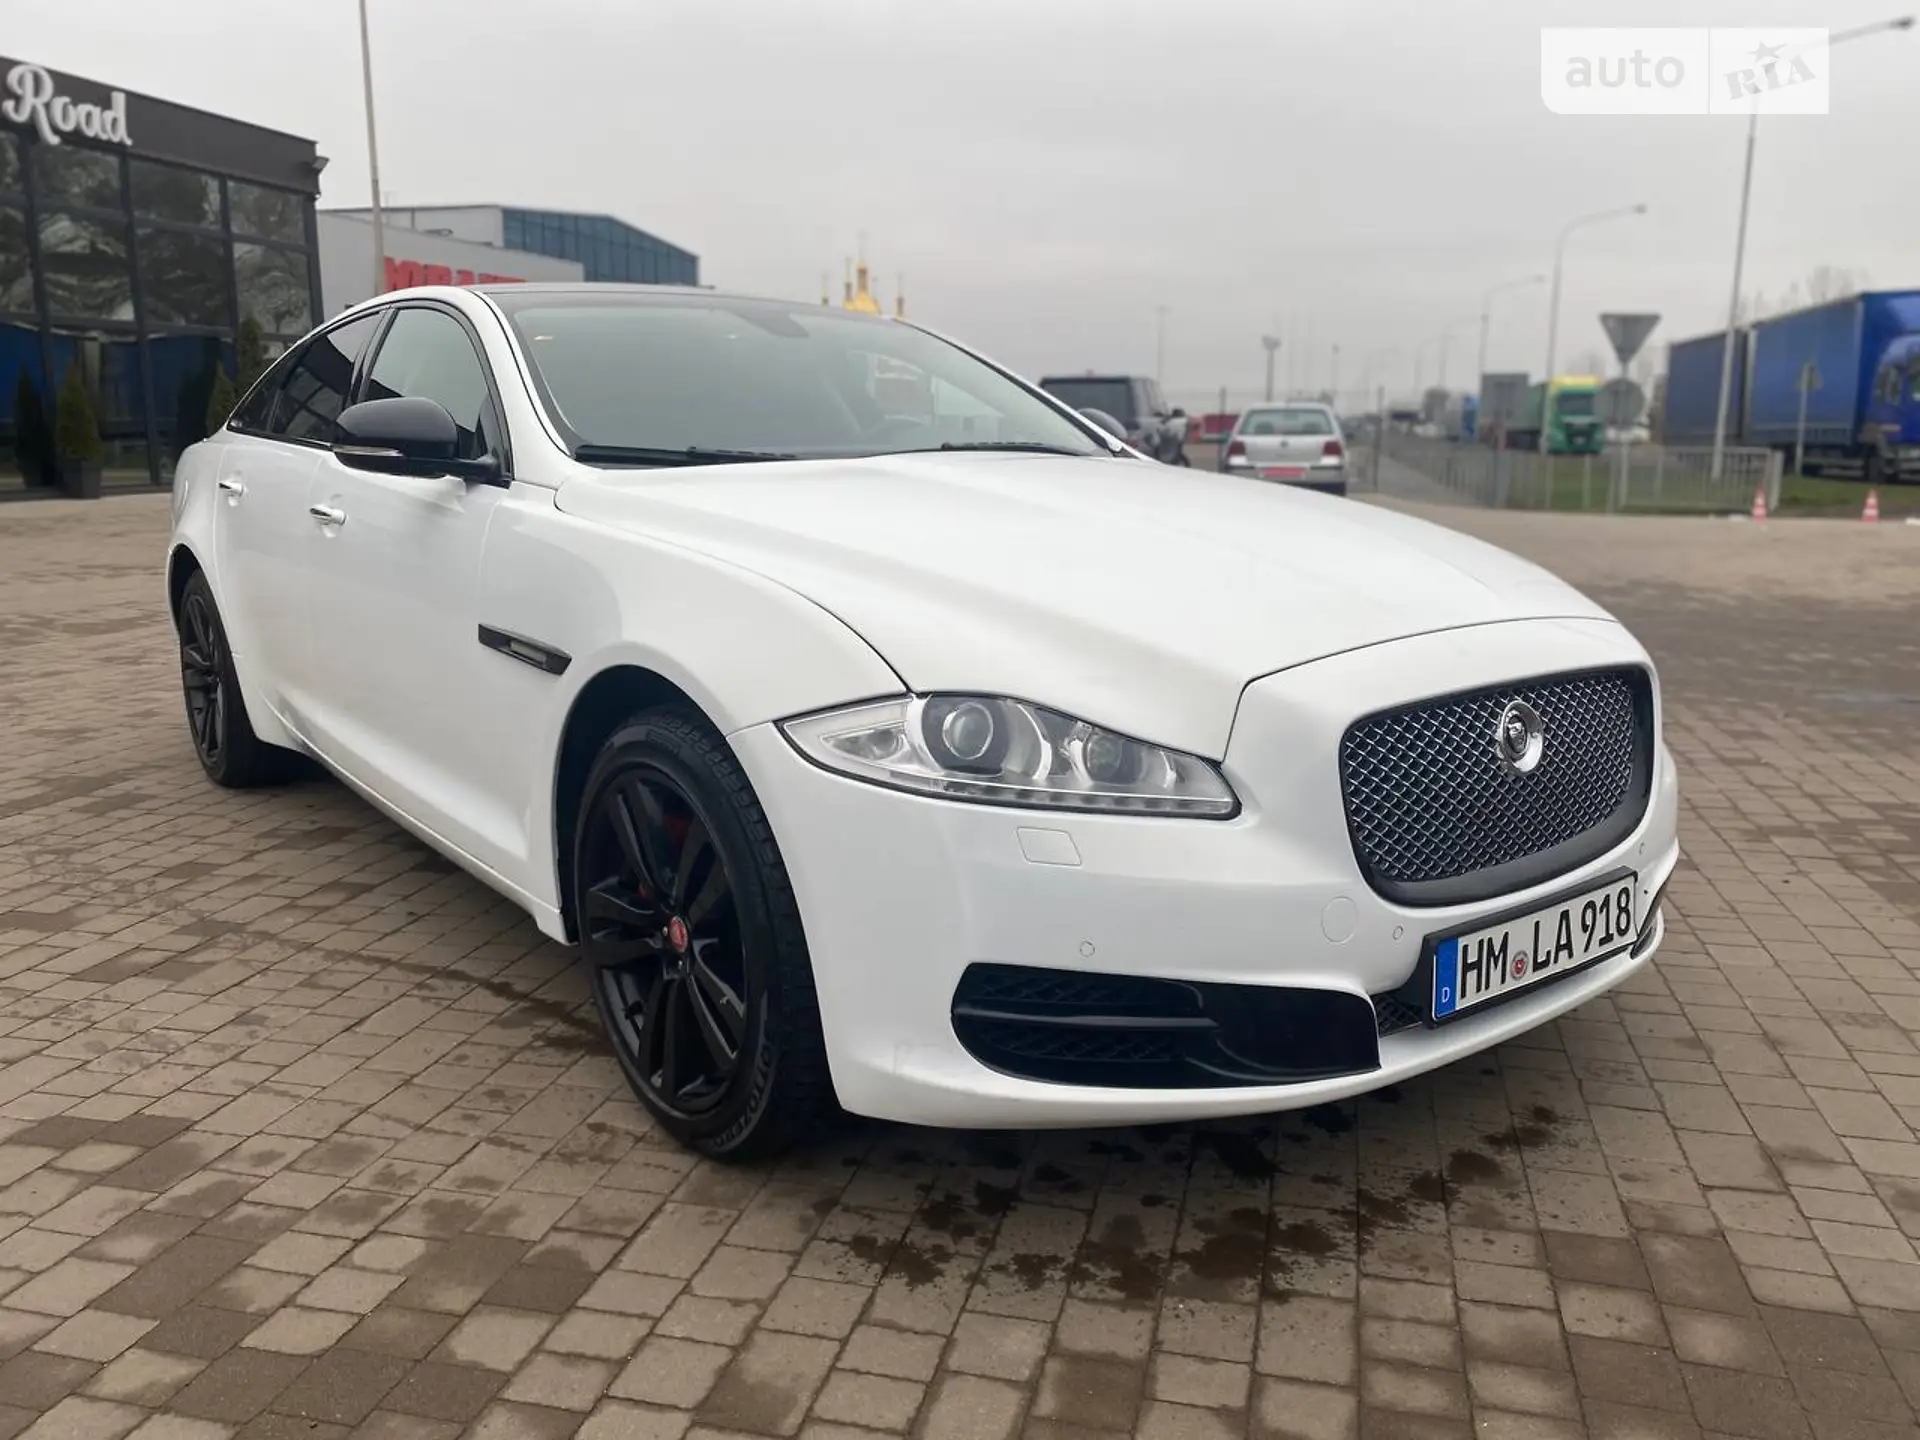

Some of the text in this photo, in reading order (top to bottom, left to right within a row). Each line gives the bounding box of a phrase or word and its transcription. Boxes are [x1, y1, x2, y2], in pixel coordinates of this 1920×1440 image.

[2, 64, 133, 146] Road
[1441, 986, 1451, 1004] D
[1460, 931, 1509, 999] HM
